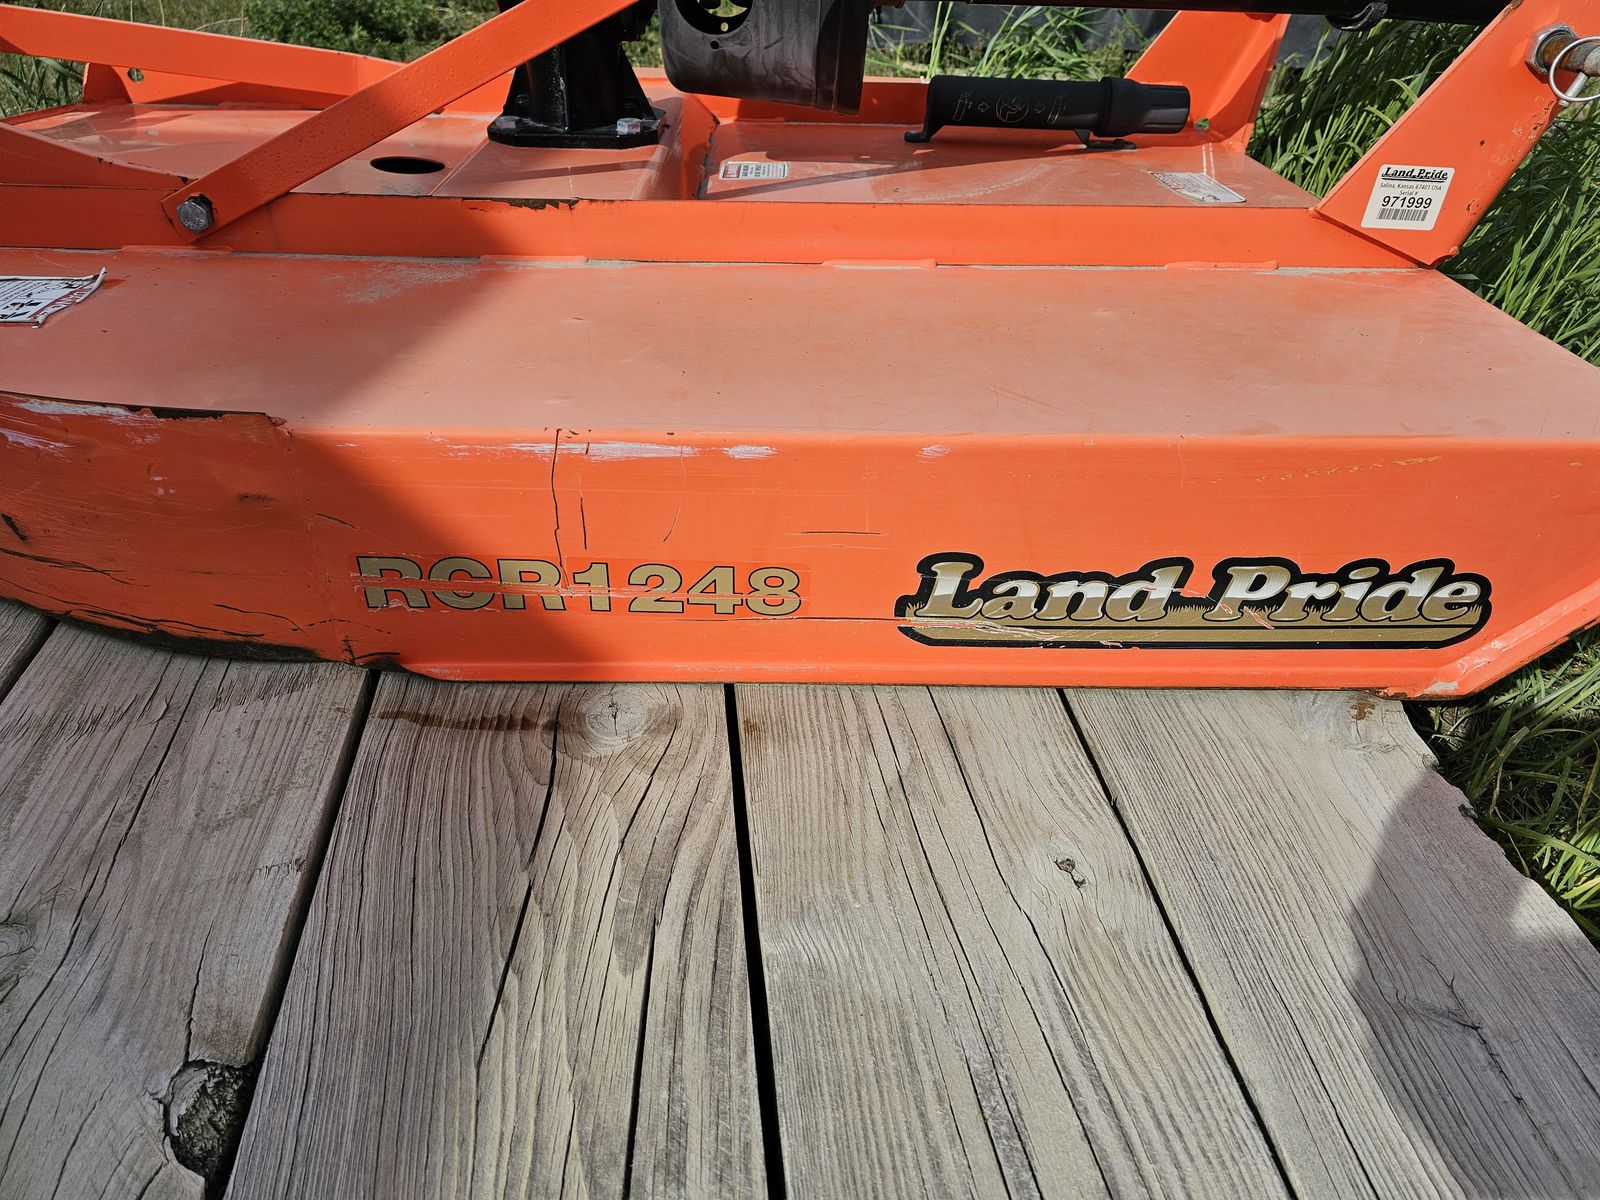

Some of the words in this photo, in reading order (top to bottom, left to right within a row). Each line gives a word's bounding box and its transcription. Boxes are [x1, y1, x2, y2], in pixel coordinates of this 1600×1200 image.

[1382, 167, 1415, 178] Land
[1416, 169, 1448, 180] Pride
[1381, 195, 1432, 209] 971999
[356, 556, 802, 616] RCR1248
[912, 560, 1190, 623] Land
[1201, 564, 1482, 623] Pride
